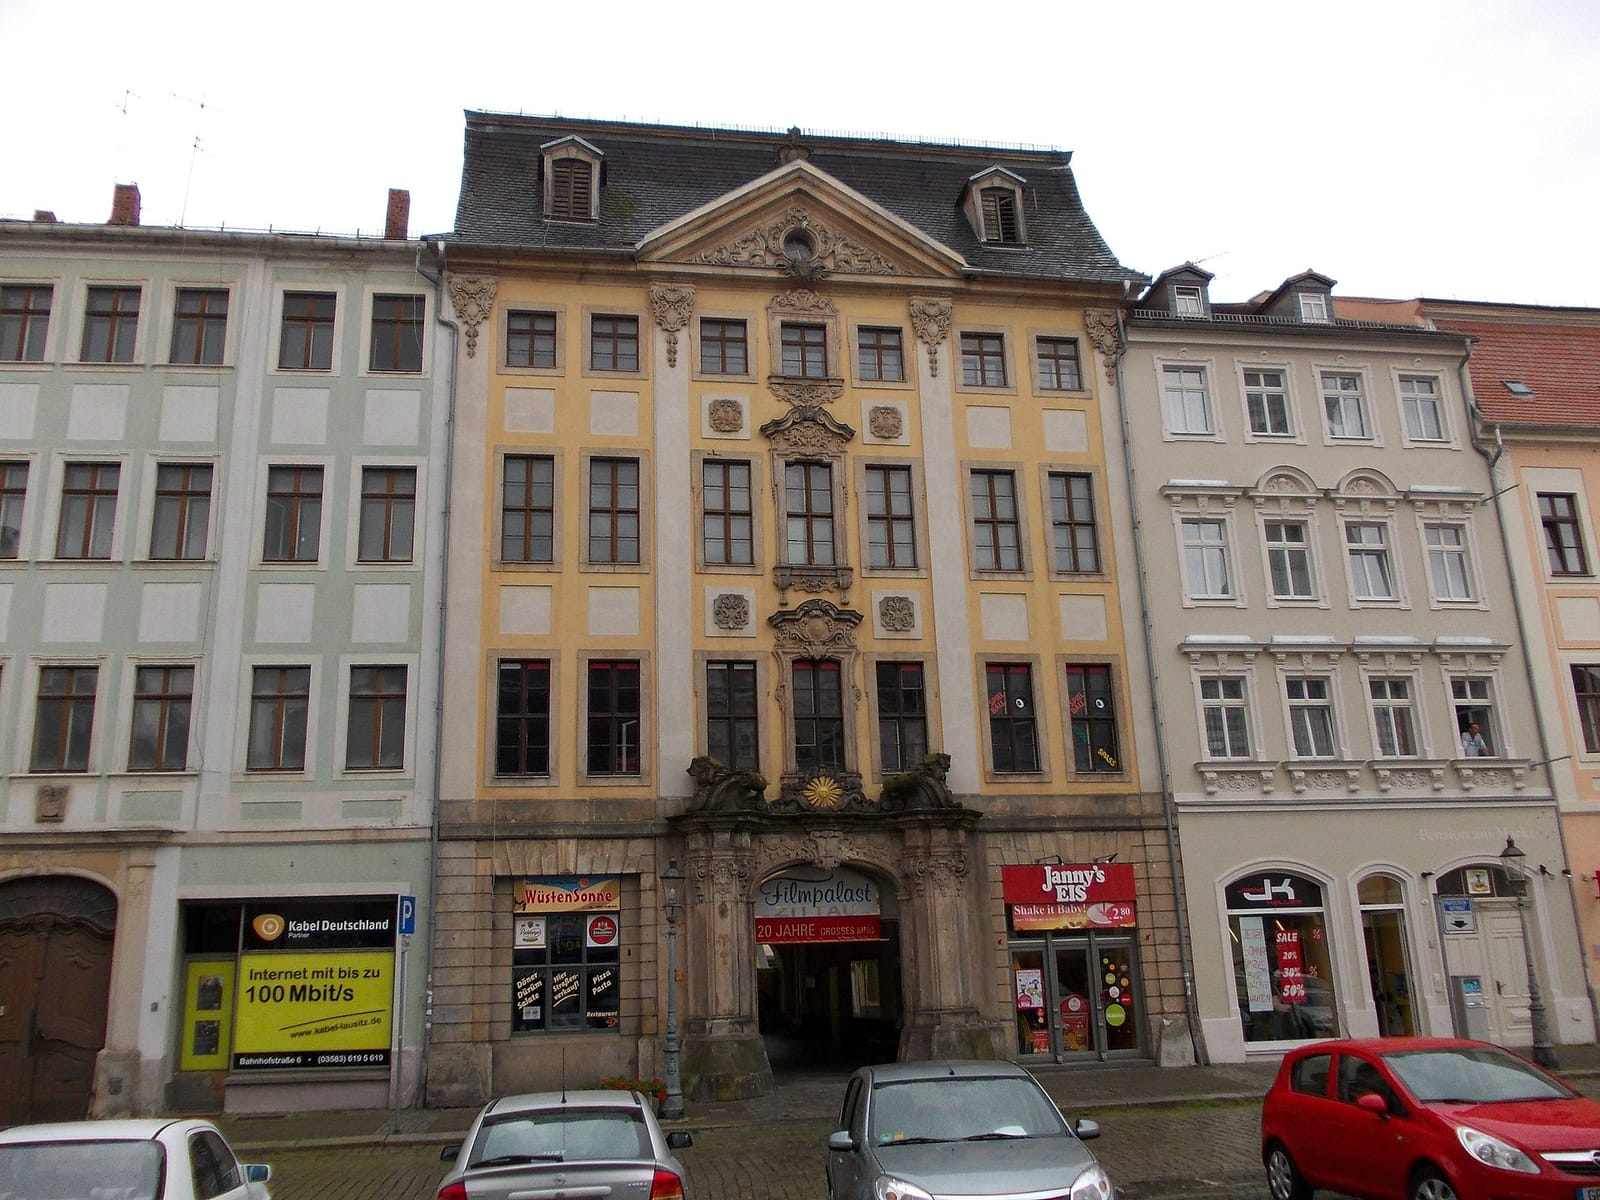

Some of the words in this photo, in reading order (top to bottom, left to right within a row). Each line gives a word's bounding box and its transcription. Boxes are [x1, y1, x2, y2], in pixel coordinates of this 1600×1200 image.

[1042, 865, 1105, 891] Janny's
[524, 888, 613, 904] WüstenSonne
[760, 874, 872, 907] Filmpalast
[1055, 884, 1087, 902] EIS
[402, 900, 412, 930] P
[1014, 905, 1045, 916] Shake
[1047, 904, 1055, 914] it
[1057, 903, 1087, 914] Baby!
[288, 920, 320, 932] Kabel
[321, 919, 389, 931] Deutschland
[757, 925, 772, 938] 20
[775, 923, 816, 937] JAHRE
[820, 927, 855, 936] GROSSES
[1276, 932, 1298, 943] SALE
[1282, 951, 1298, 960] 20%
[249, 968, 308, 981] Internet
[312, 967, 334, 979] mit
[338, 967, 359, 979] bis
[363, 968, 380, 979] zu
[553, 971, 567, 983] Hier
[592, 970, 612, 984] Pizza
[1282, 967, 1301, 978] 30%
[516, 972, 538, 989] Döner
[592, 980, 612, 995] Pasta
[245, 985, 285, 1003] 100
[289, 984, 355, 1002] Mbit/s
[517, 980, 543, 999] Dürüm
[1282, 983, 1305, 997] 50%
[586, 1010, 618, 1018] Restaurant
[290, 1017, 382, 1039] www.kabel-lausitz.de
[239, 1056, 296, 1066] Bahnhofstraße
[317, 1055, 347, 1065] (03583)
[347, 1055, 362, 1063] 619
[369, 1054, 384, 1062] 619
